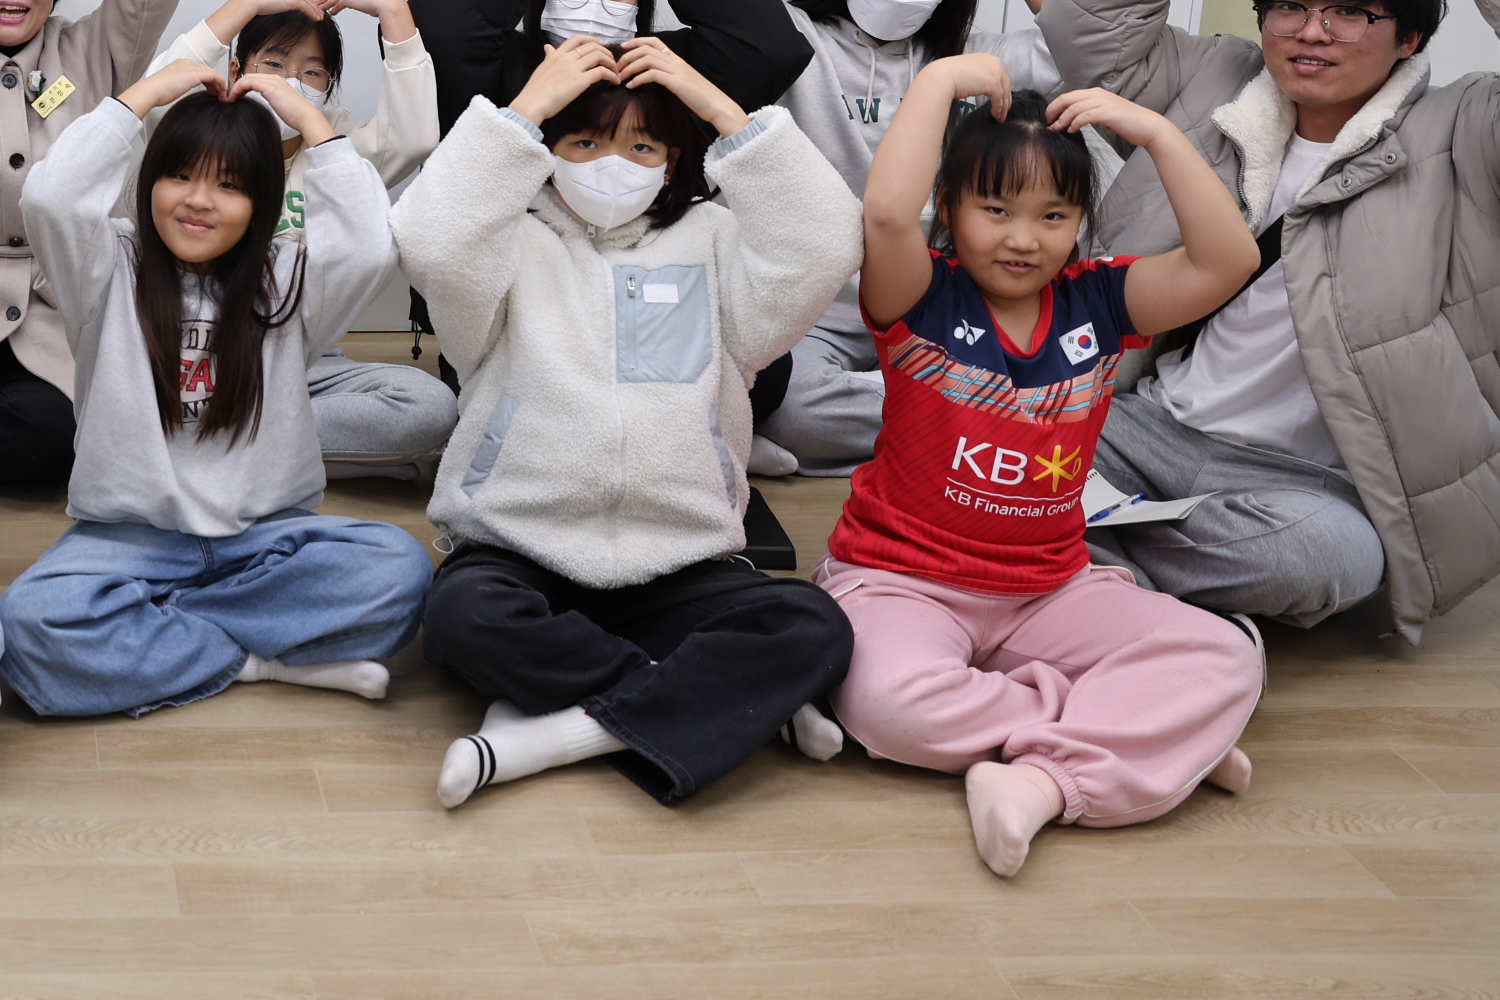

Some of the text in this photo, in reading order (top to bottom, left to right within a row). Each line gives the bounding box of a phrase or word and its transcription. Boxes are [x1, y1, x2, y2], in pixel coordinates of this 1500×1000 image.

[951, 436, 1028, 486] KB
[944, 485, 971, 507] KB
[973, 497, 1045, 517] Financial
